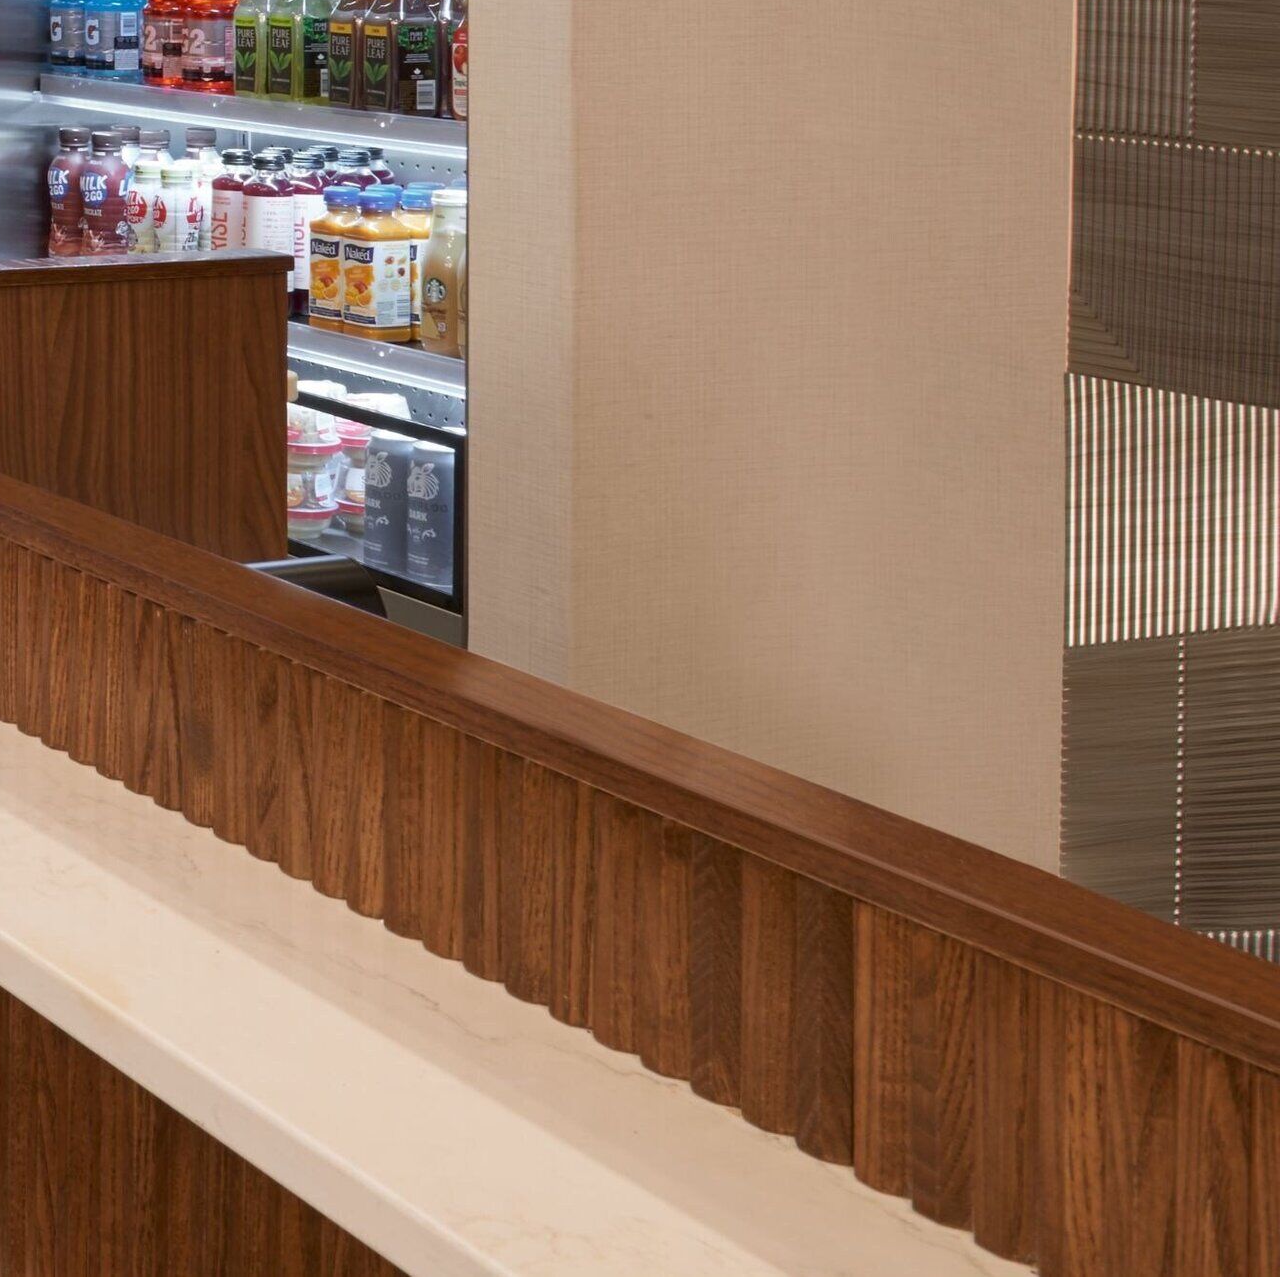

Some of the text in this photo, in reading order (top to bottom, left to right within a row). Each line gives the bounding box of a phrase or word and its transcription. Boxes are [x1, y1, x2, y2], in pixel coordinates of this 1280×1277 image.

[237, 28, 254, 37] PURE
[272, 28, 290, 38] PURE
[237, 37, 254, 48] LEAF
[272, 38, 290, 48] LEAF
[332, 36, 350, 45] PURE
[367, 38, 385, 48] PURE
[332, 46, 350, 56] LEAF
[367, 48, 385, 59] LEAF
[85, 191, 103, 202] 2GO
